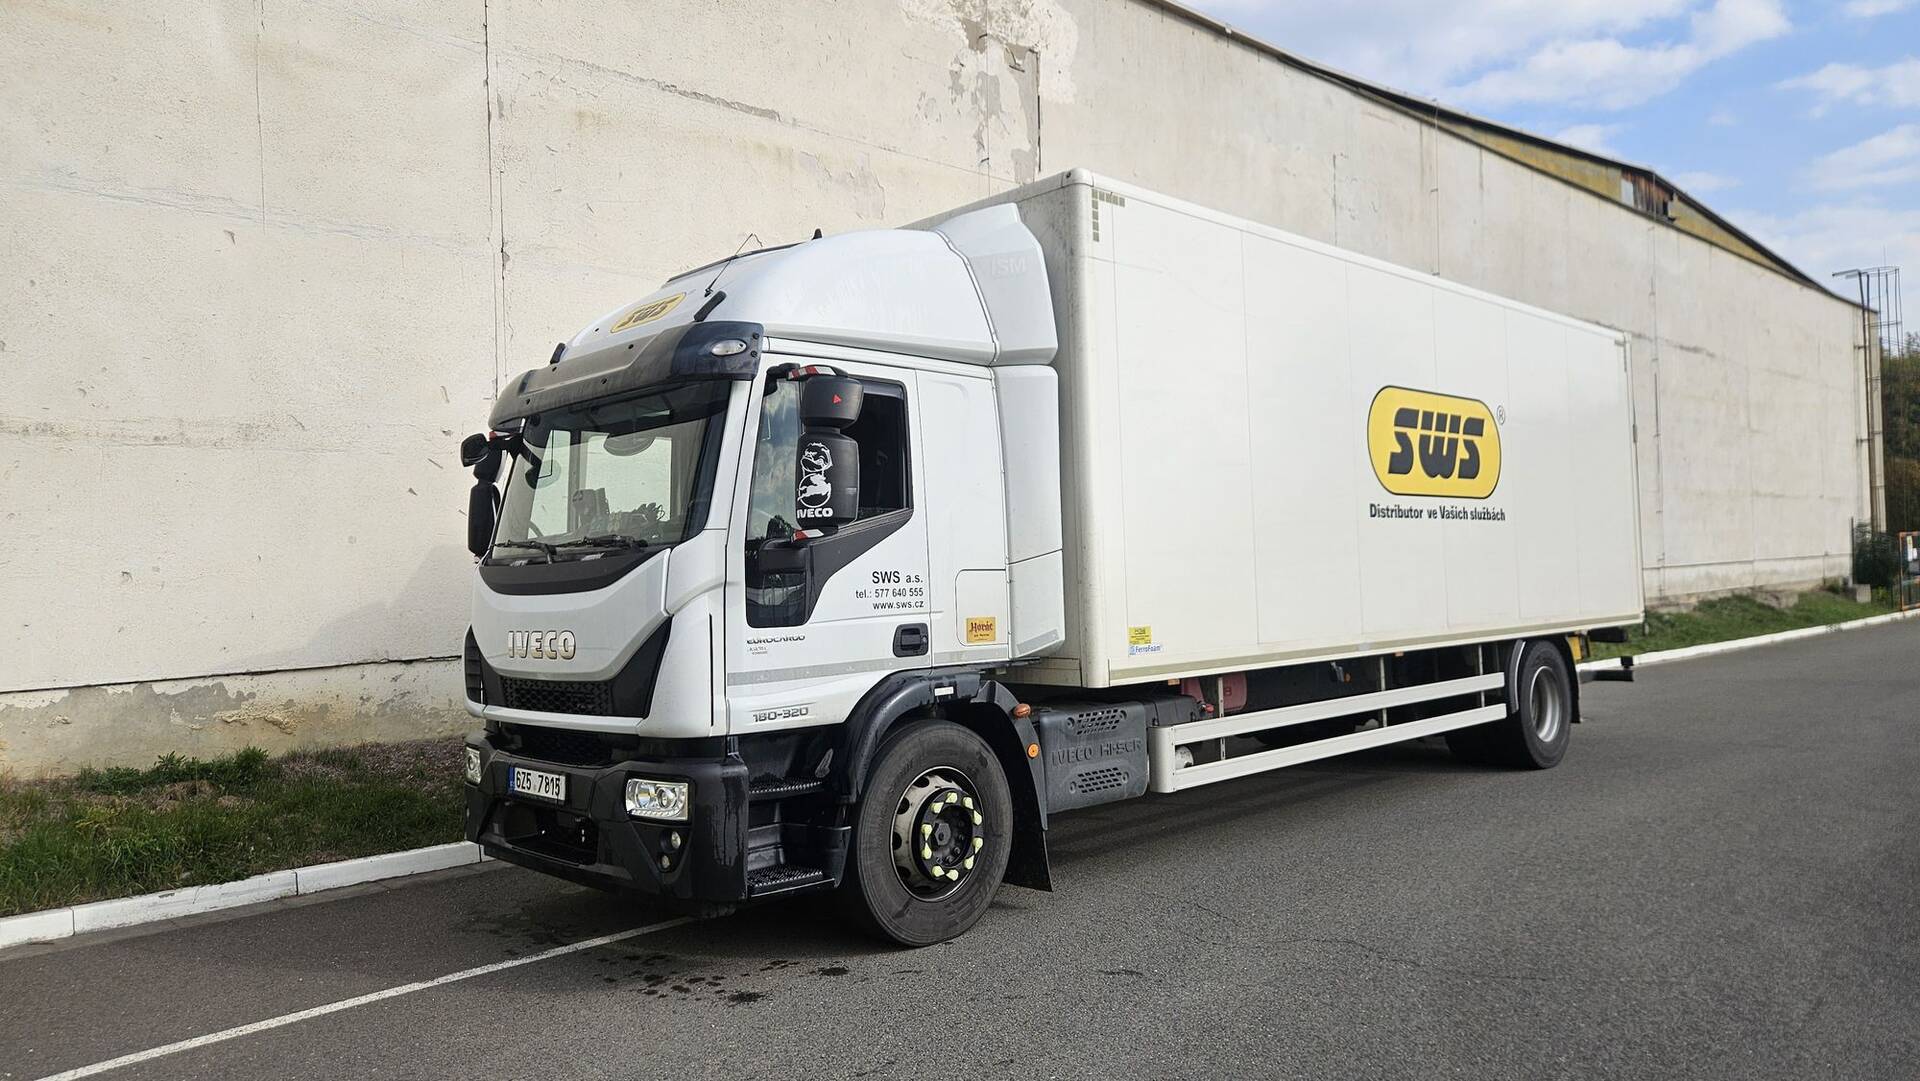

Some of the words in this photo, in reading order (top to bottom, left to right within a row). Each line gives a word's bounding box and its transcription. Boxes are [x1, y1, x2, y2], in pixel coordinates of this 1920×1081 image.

[1388, 407, 1485, 480] SWS
[796, 507, 833, 519] IVECO
[1369, 503, 1424, 519] Distributor
[1427, 508, 1438, 520] ve
[1439, 504, 1469, 520] Vašich
[1470, 506, 1506, 521] službách
[872, 570, 901, 584] SWS
[905, 574, 924, 583] a.s.
[855, 589, 872, 599] tel.:
[874, 588, 890, 598] 577
[892, 588, 907, 598] 640
[909, 587, 924, 597] 555
[872, 600, 925, 610] www.sws.cz
[507, 629, 577, 660] IVECO
[1051, 746, 1093, 767] IVECO
[516, 770, 532, 790] 6Z5
[537, 774, 561, 796] 7815
